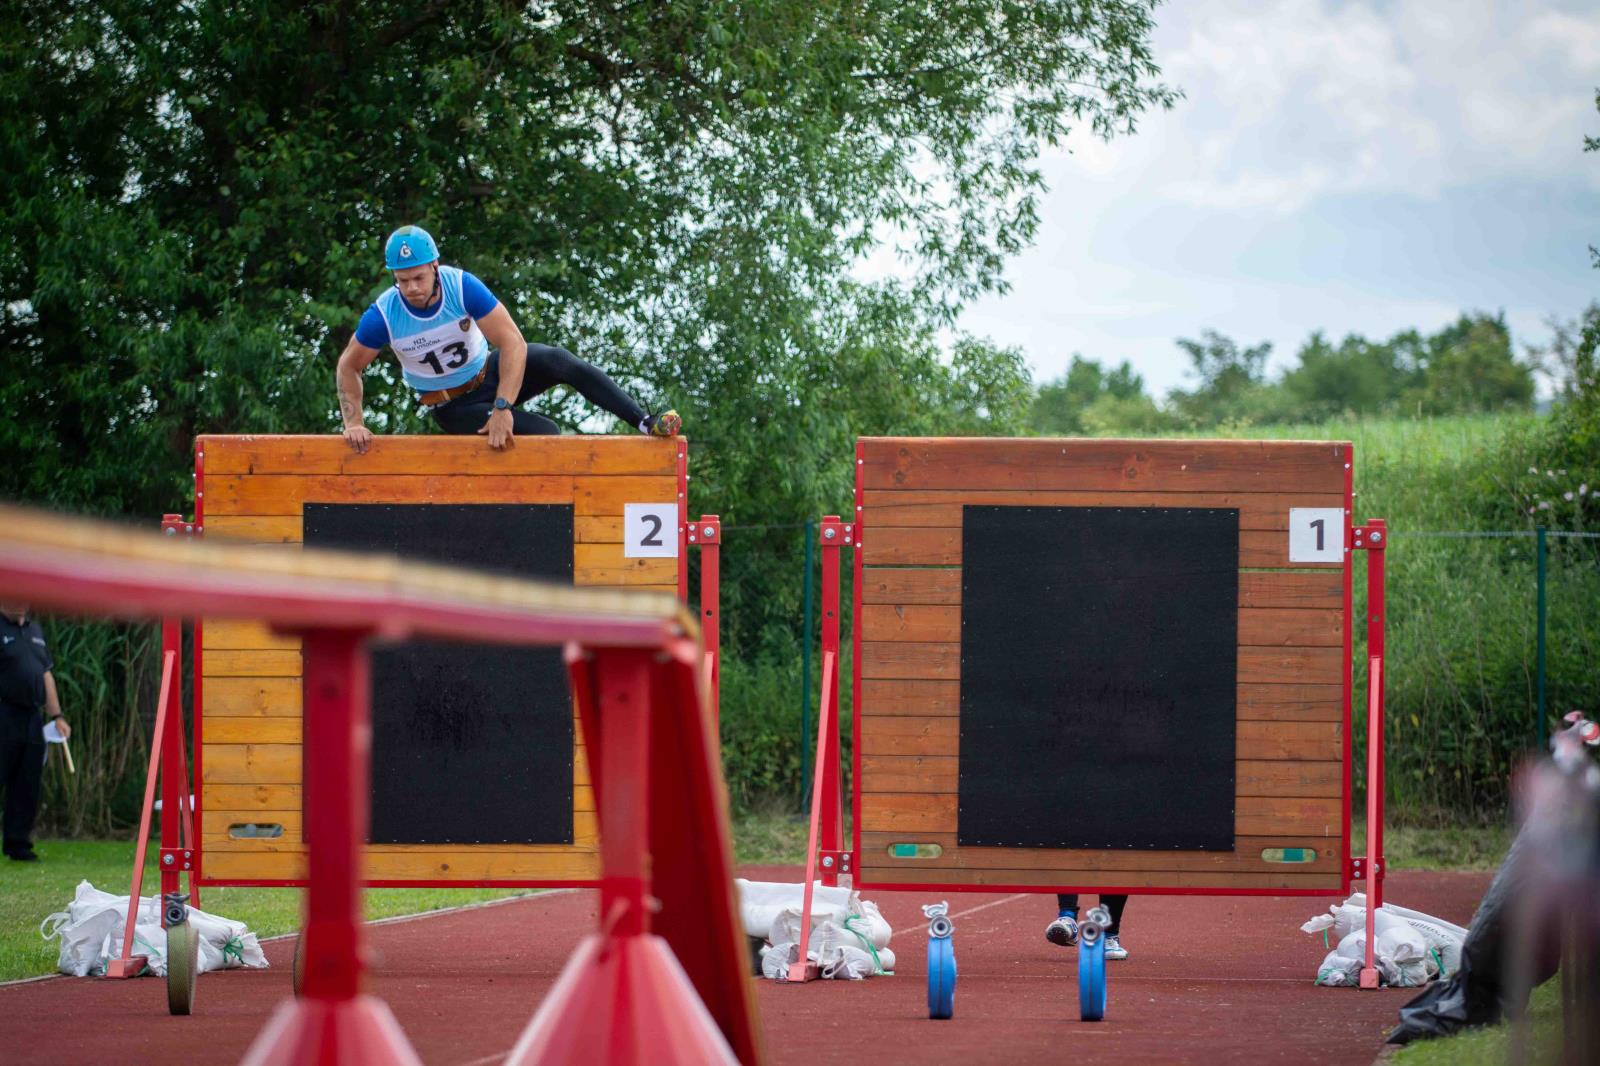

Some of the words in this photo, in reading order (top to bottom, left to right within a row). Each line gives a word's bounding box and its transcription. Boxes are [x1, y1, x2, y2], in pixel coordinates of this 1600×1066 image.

[418, 341, 469, 375] 13
[640, 514, 663, 546] 2
[1310, 519, 1324, 551] 1
